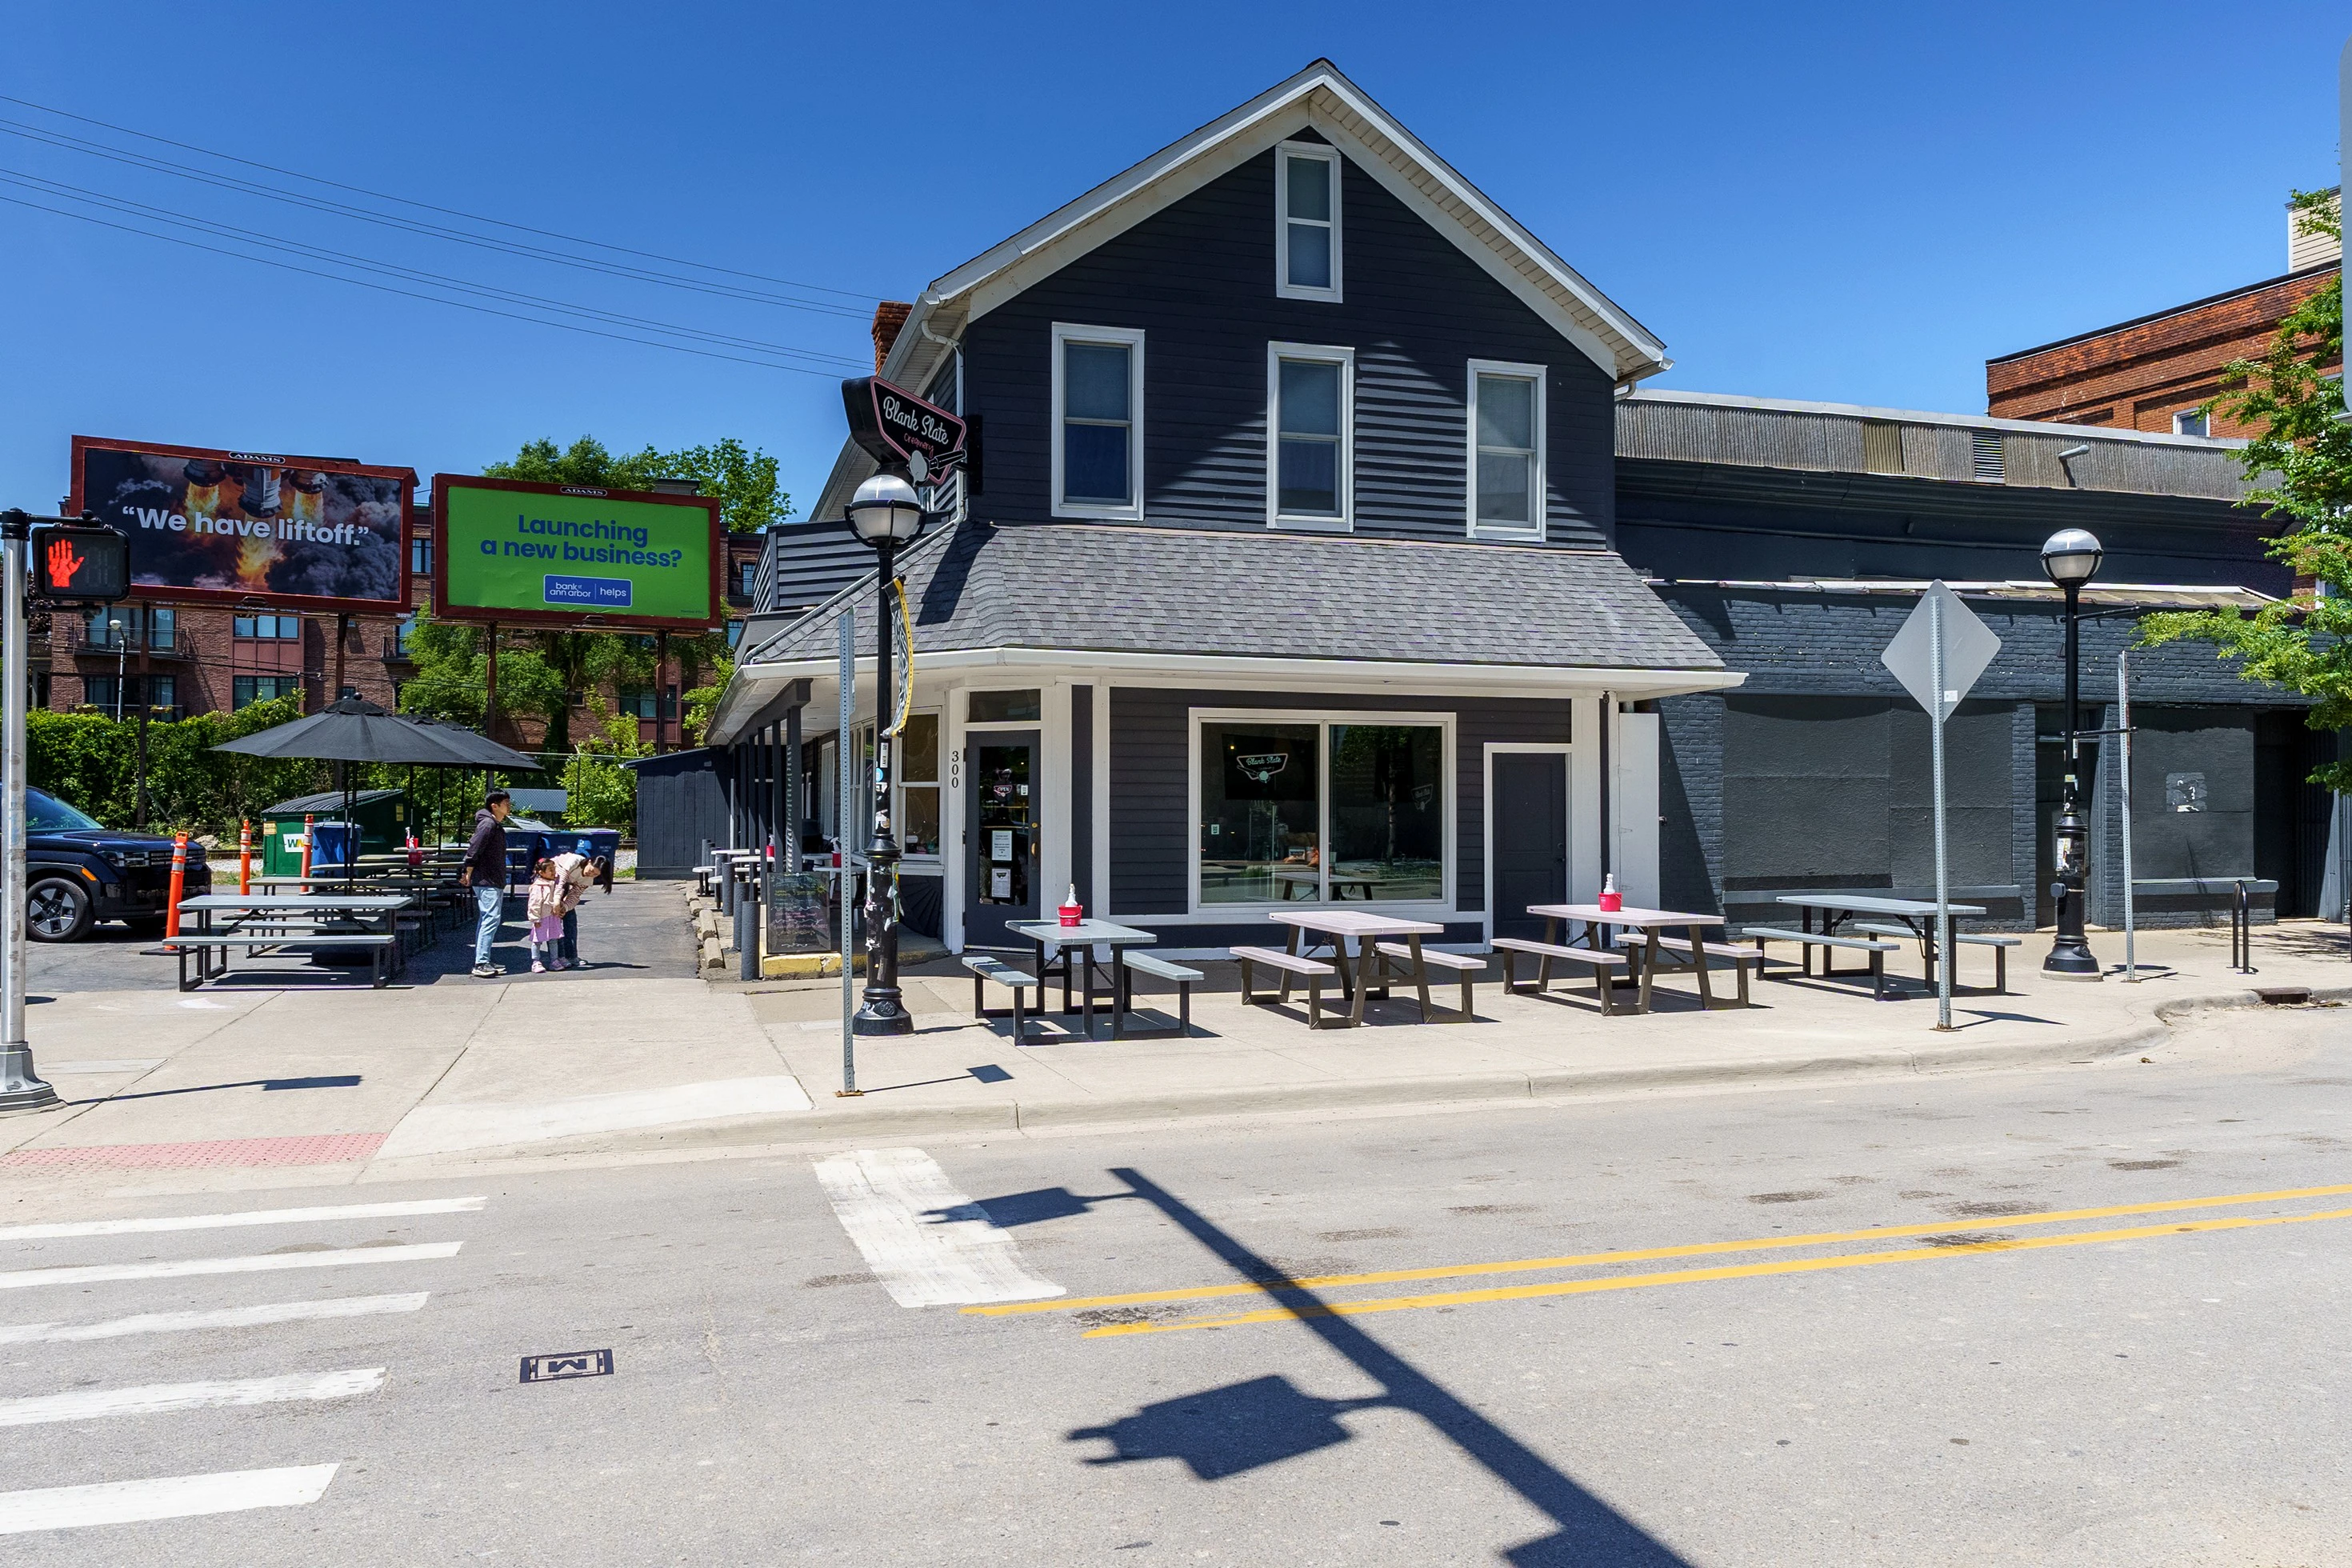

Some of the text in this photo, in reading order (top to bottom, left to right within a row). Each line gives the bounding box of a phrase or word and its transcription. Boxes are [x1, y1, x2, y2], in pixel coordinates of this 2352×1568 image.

[883, 396, 949, 445] Blank Slate
[234, 454, 281, 462] ADAMS
[194, 511, 271, 538] have
[518, 514, 649, 548] Launching
[480, 539, 682, 567] a new business?
[555, 582, 578, 590] bank
[600, 587, 627, 598] helps
[951, 750, 959, 788] 300
[1246, 756, 1282, 766] Blank Slate
